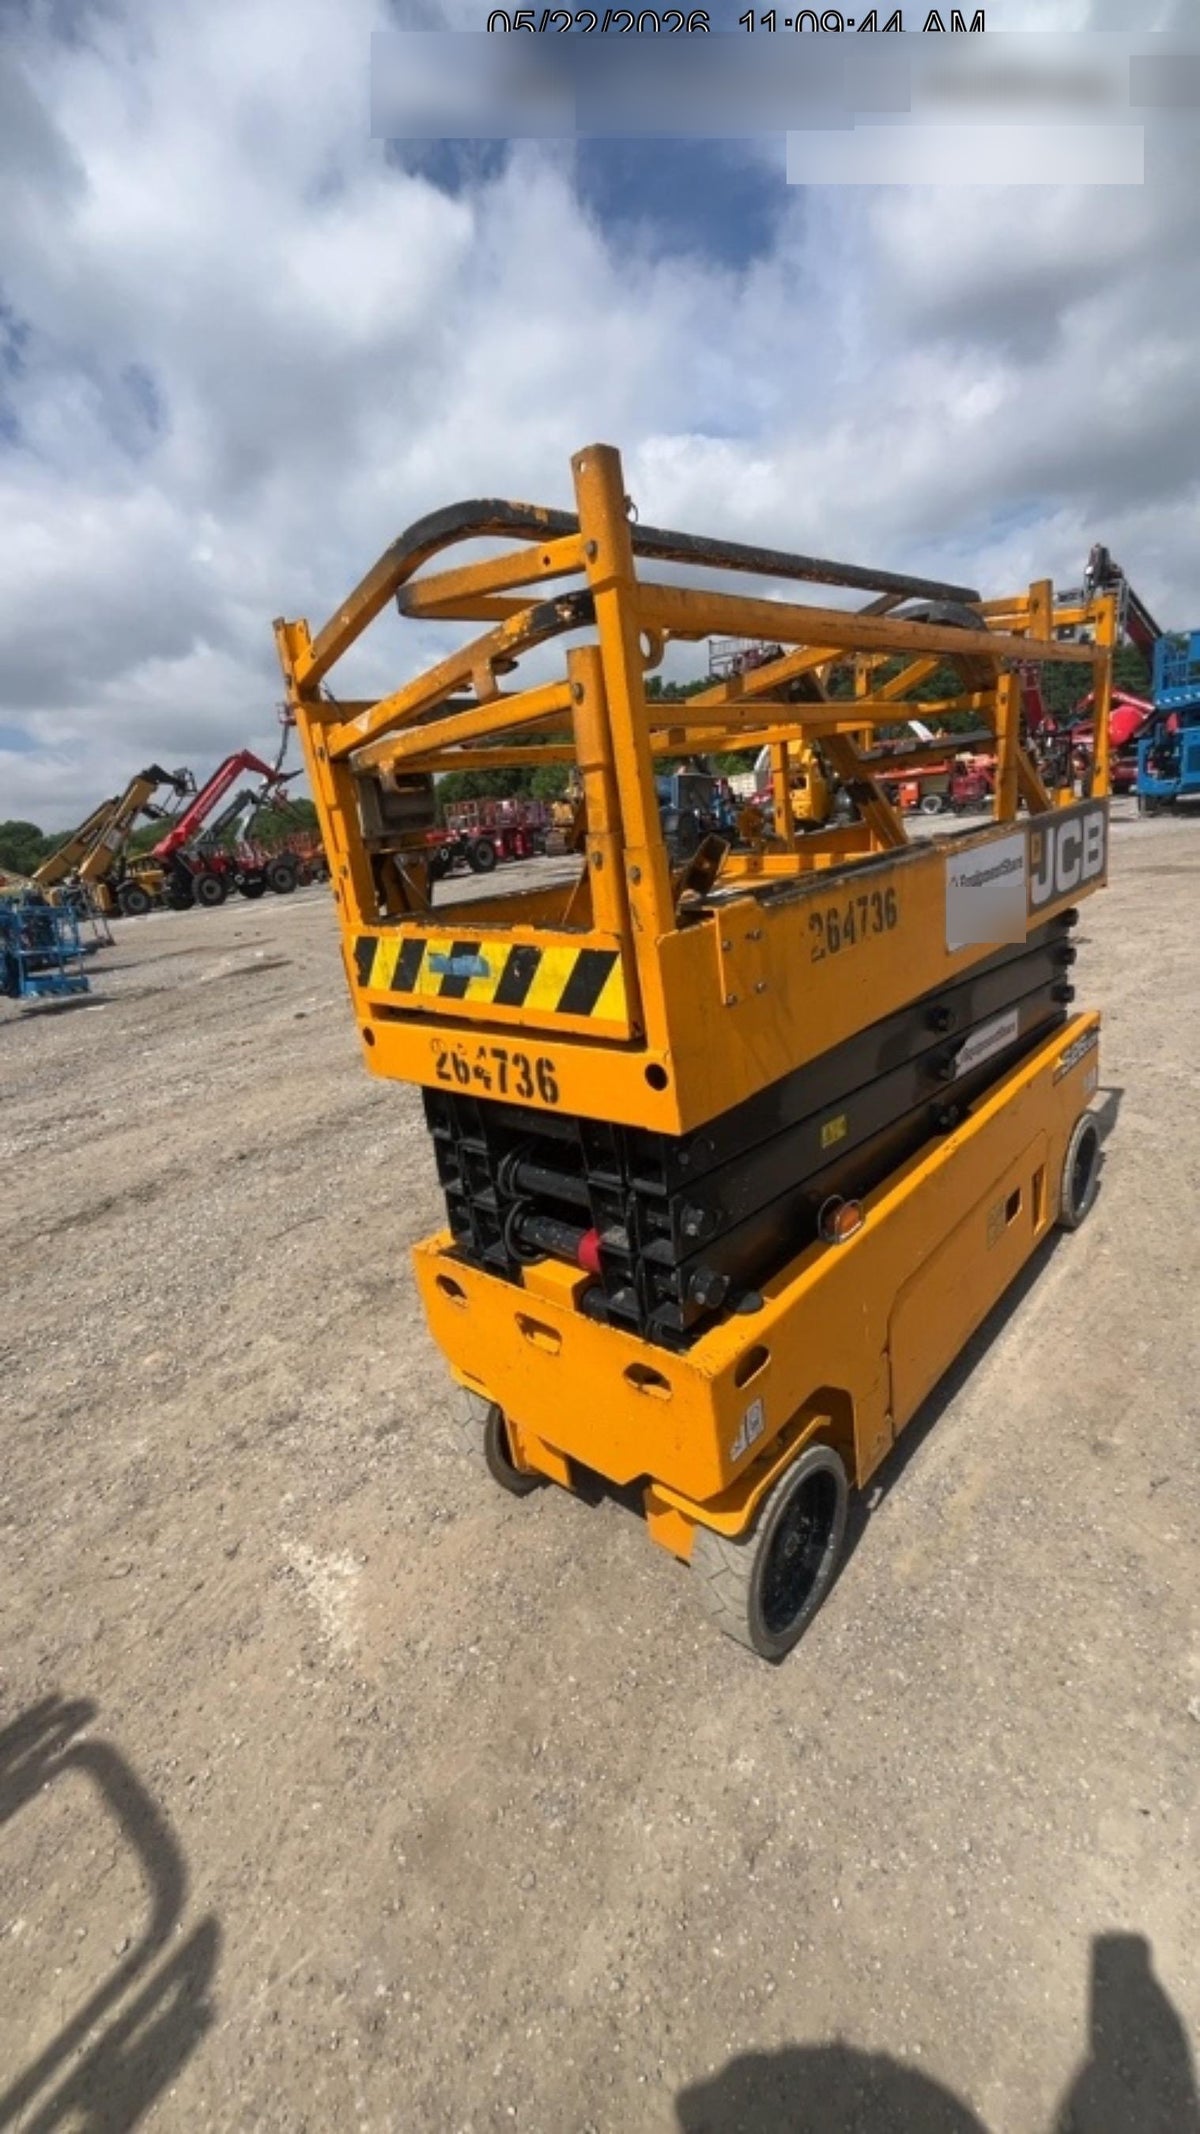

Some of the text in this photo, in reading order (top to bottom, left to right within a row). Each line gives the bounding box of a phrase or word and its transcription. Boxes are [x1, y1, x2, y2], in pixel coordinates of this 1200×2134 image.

[1031, 811, 1104, 905] JCB
[808, 887, 898, 964] 264736
[434, 1044, 559, 1105] 264736
